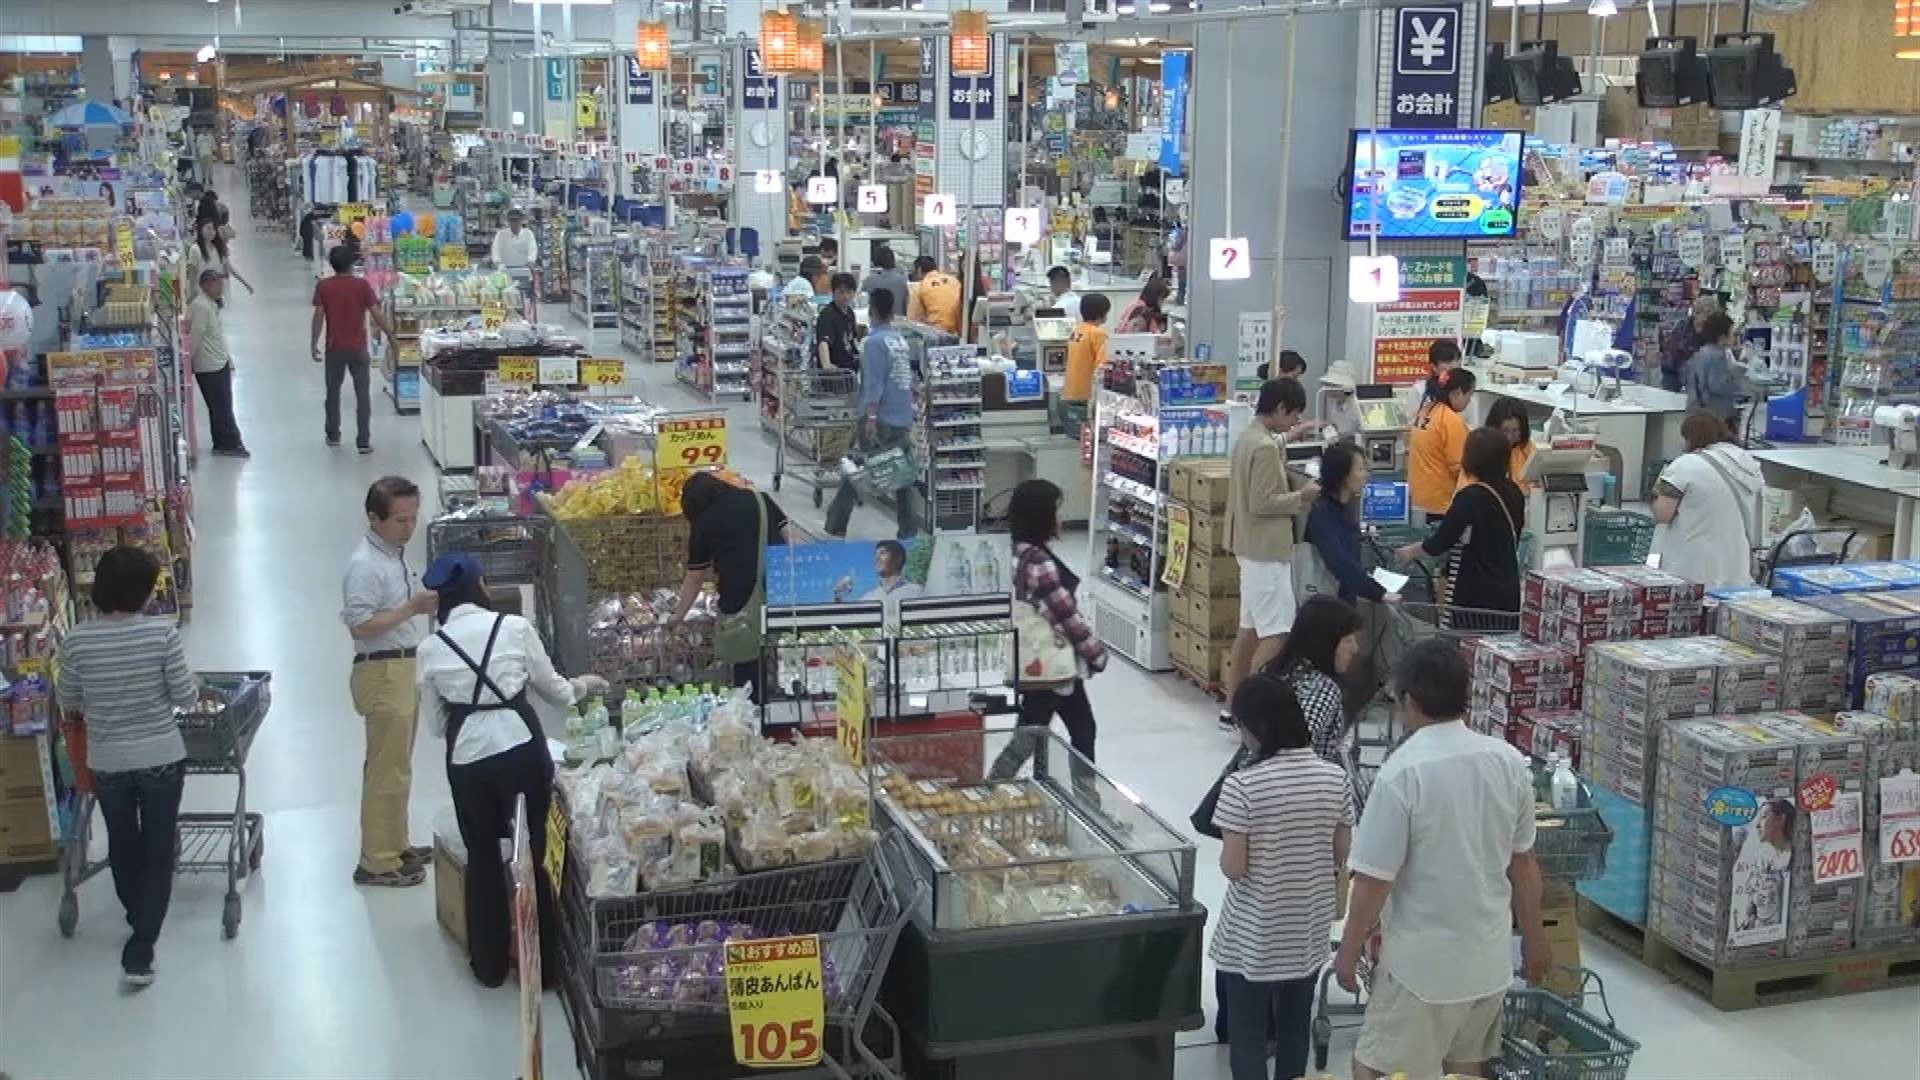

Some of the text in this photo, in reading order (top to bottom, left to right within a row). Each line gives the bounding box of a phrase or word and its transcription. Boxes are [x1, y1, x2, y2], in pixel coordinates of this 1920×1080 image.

[1396, 92, 1454, 114] お会計
[684, 162, 693, 174] 9
[720, 168, 729, 180] 8
[597, 374, 622, 384] 99
[671, 431, 716, 442] カップめん
[681, 446, 723, 465] 99
[746, 940, 816, 960] おすすめ品
[740, 1019, 818, 1061] 105
